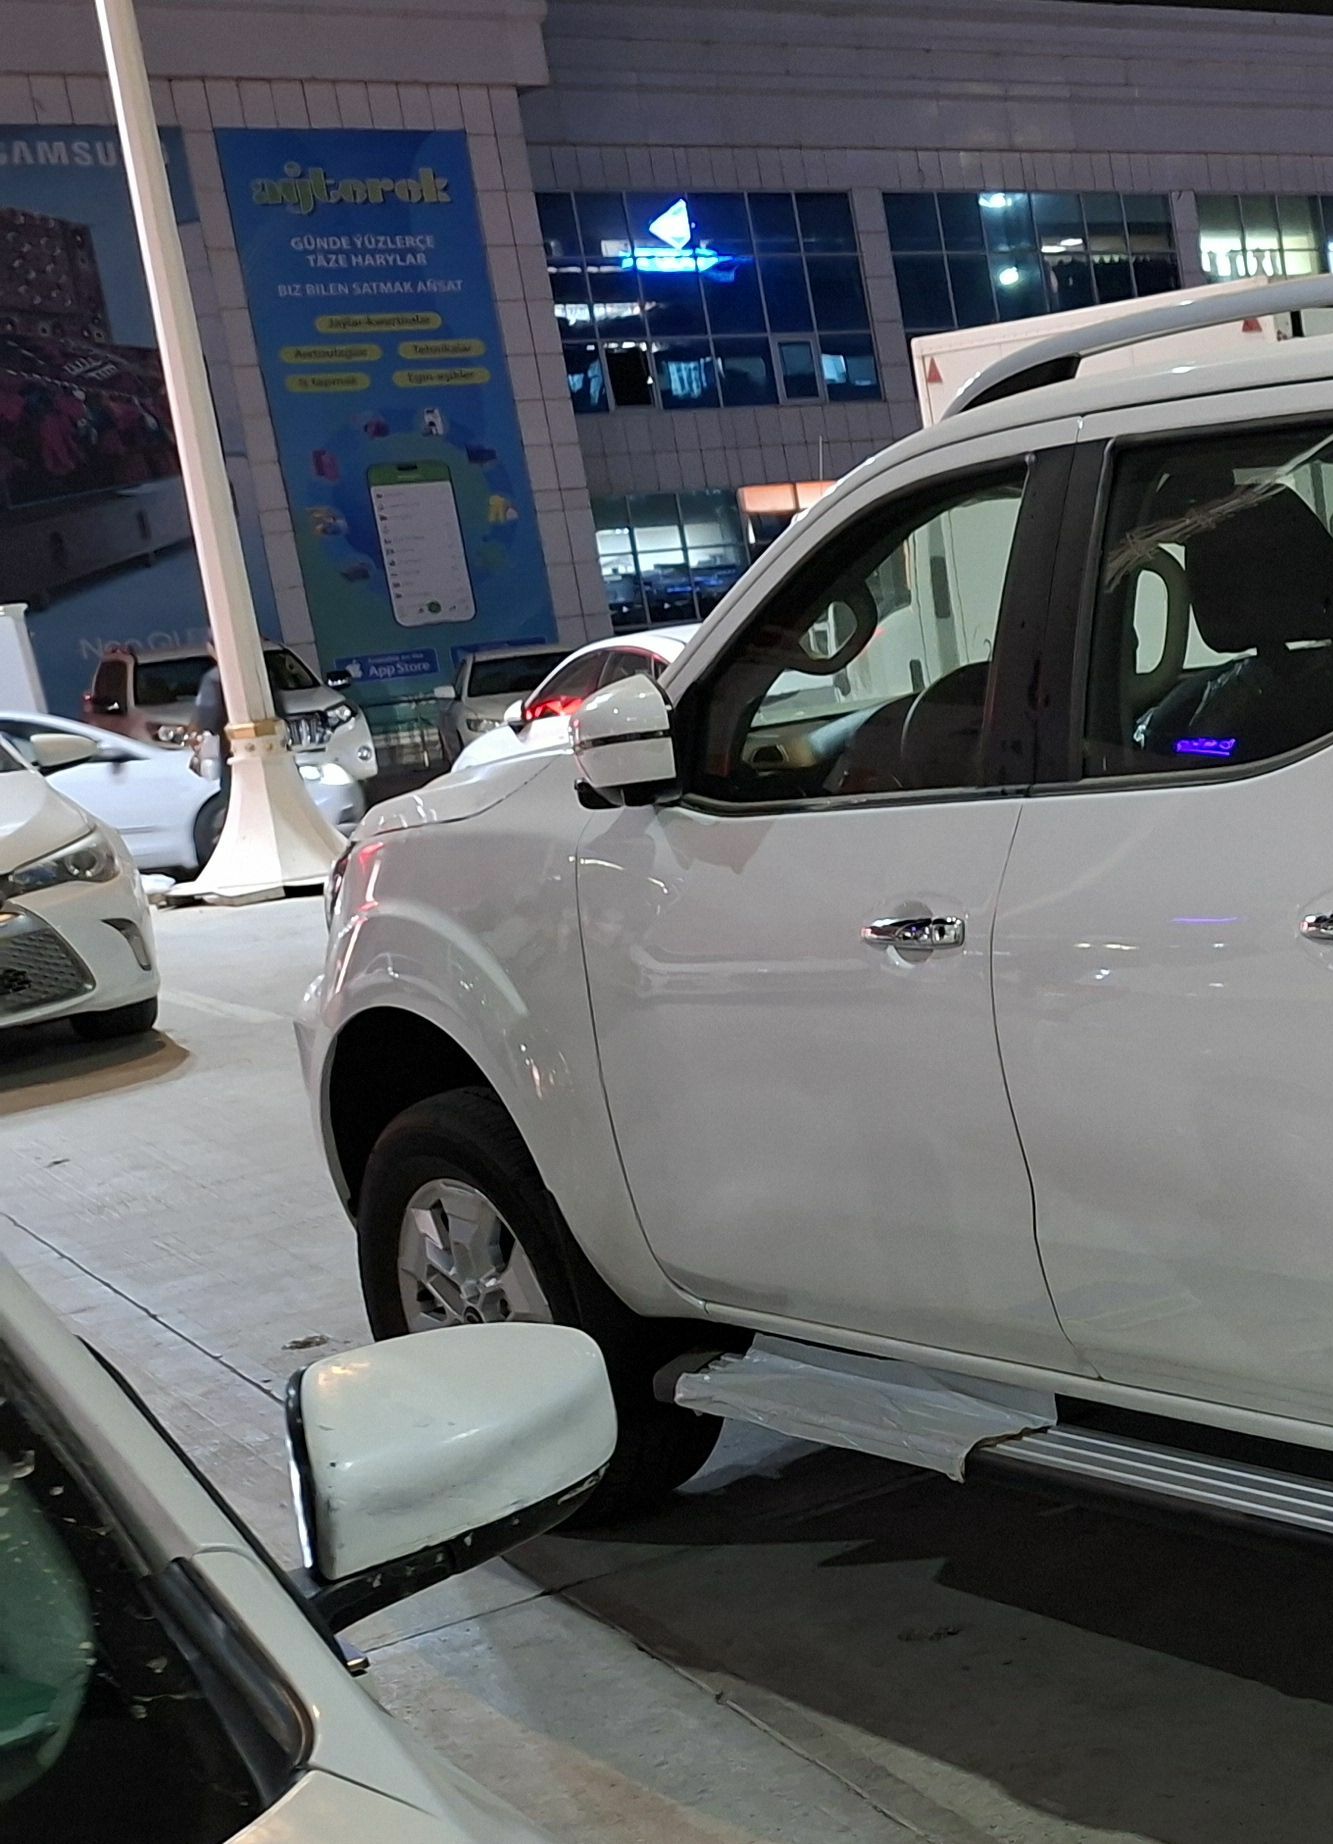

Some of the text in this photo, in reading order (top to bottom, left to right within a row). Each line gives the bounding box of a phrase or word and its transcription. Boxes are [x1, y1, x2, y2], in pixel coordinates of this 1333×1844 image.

[0, 140, 169, 167] AMSU
[290, 234, 351, 251] GÜNDE
[351, 252, 428, 267] HARYLAR
[352, 281, 413, 294] SATMAK
[368, 661, 430, 678] App Store
